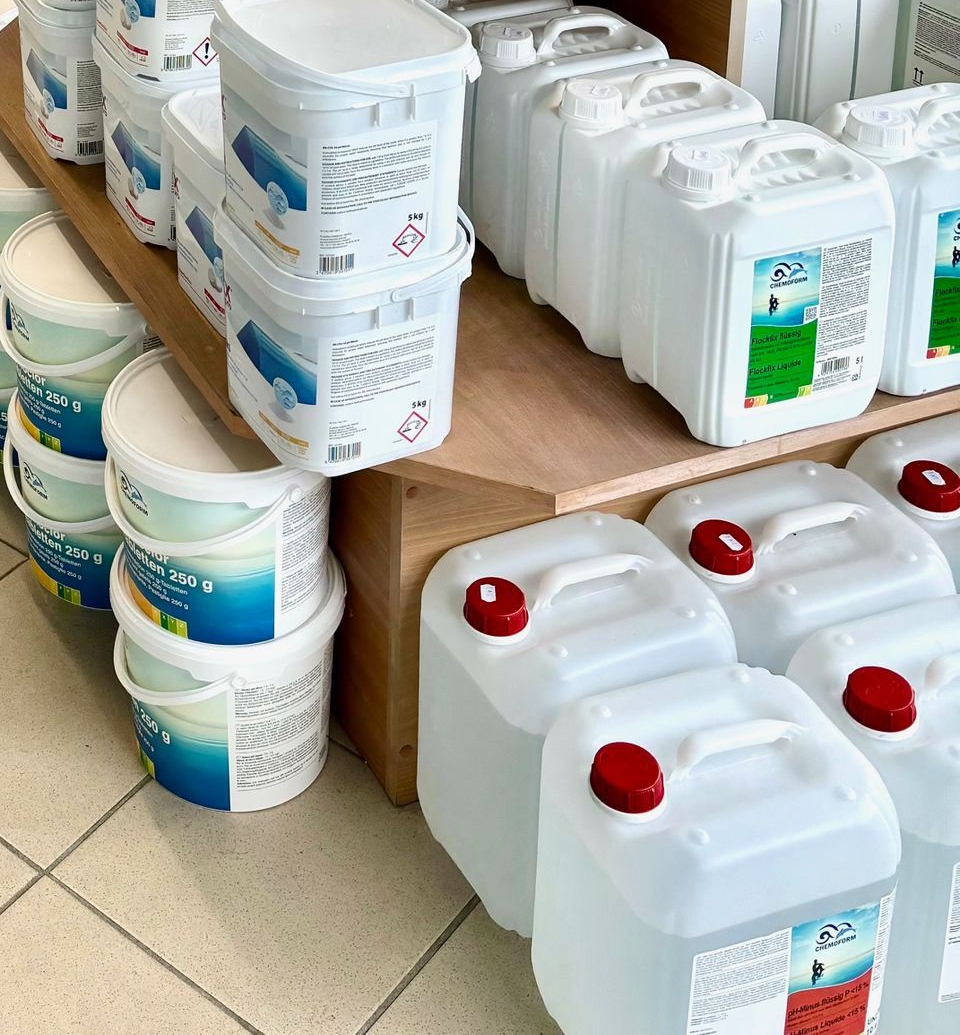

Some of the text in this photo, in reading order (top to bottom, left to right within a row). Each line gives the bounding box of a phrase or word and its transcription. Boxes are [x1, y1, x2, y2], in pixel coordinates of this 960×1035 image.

[413, 212, 424, 221] kg
[769, 276, 808, 289] CHEMOFORM
[933, 316, 958, 326] Flockfix
[751, 329, 801, 345] Flockfix flüssig
[749, 360, 801, 375] Flockfix Liquide
[45, 390, 81, 413] 250 g
[65, 545, 103, 565] 250 g
[169, 569, 213, 593] 250 g
[171, 598, 183, 607] 250
[141, 710, 171, 745] 250 g
[814, 934, 857, 953] CHEMOFORM
[787, 1001, 820, 1019] pH-Minus
[821, 992, 844, 1006] flüssig
[844, 989, 850, 998] P
[850, 984, 862, 994] <15
[820, 1015, 846, 1029] Liquide
[847, 1009, 859, 1018] <15
